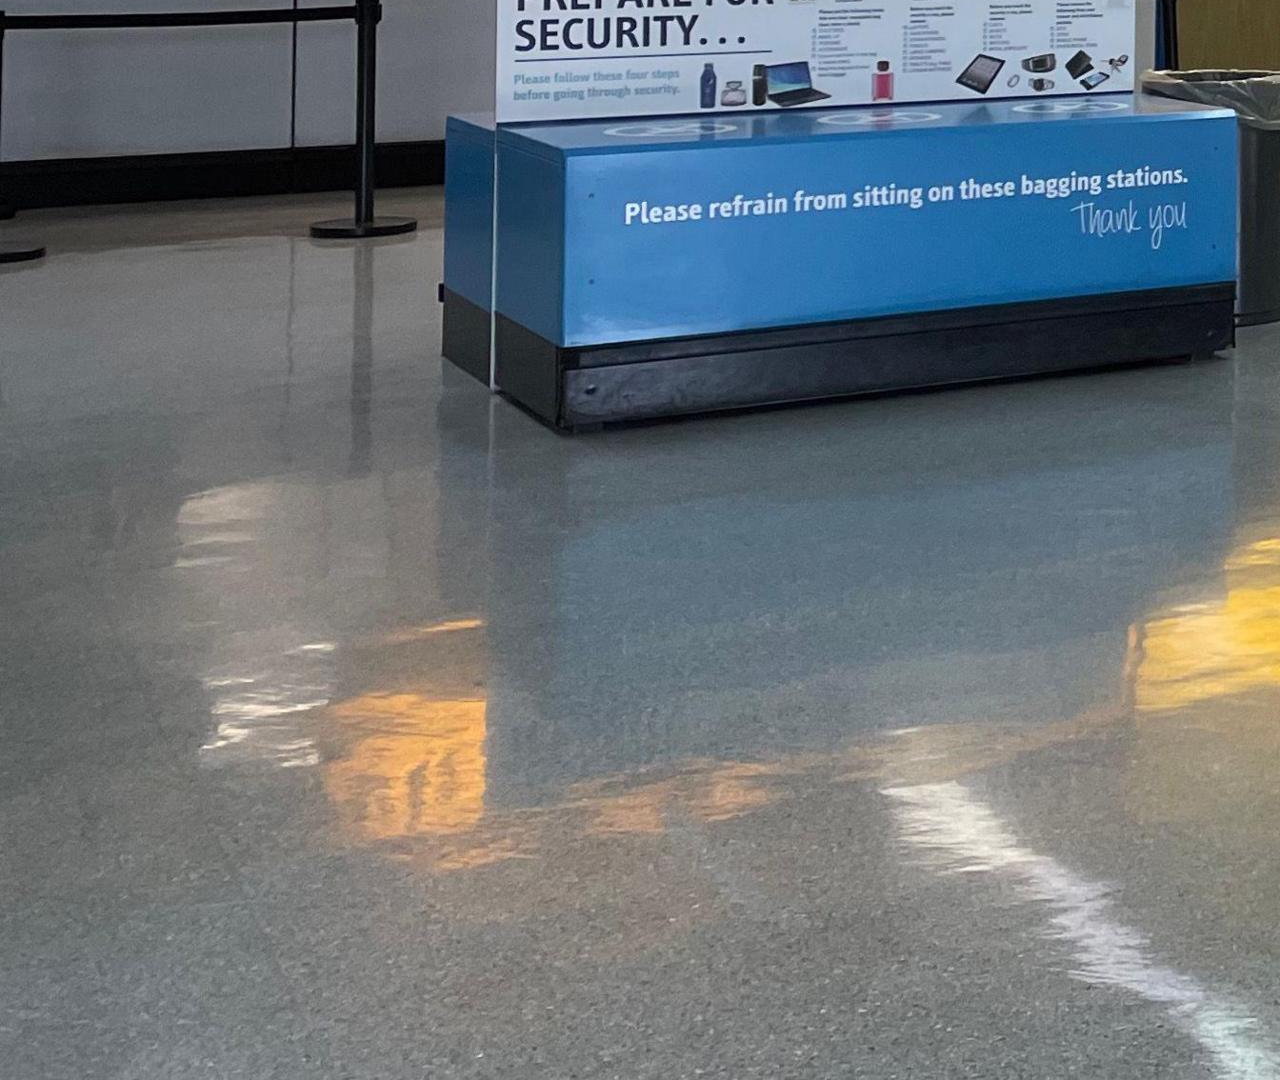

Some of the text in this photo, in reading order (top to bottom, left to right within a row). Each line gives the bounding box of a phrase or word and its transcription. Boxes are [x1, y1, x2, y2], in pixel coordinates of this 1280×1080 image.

[513, 68, 680, 86] Please follow these four steps
[513, 84, 681, 102] before going through security.
[624, 165, 1189, 226] Please refrain from sitting on these bagging stations.
[1069, 199, 1188, 250] Thank you
